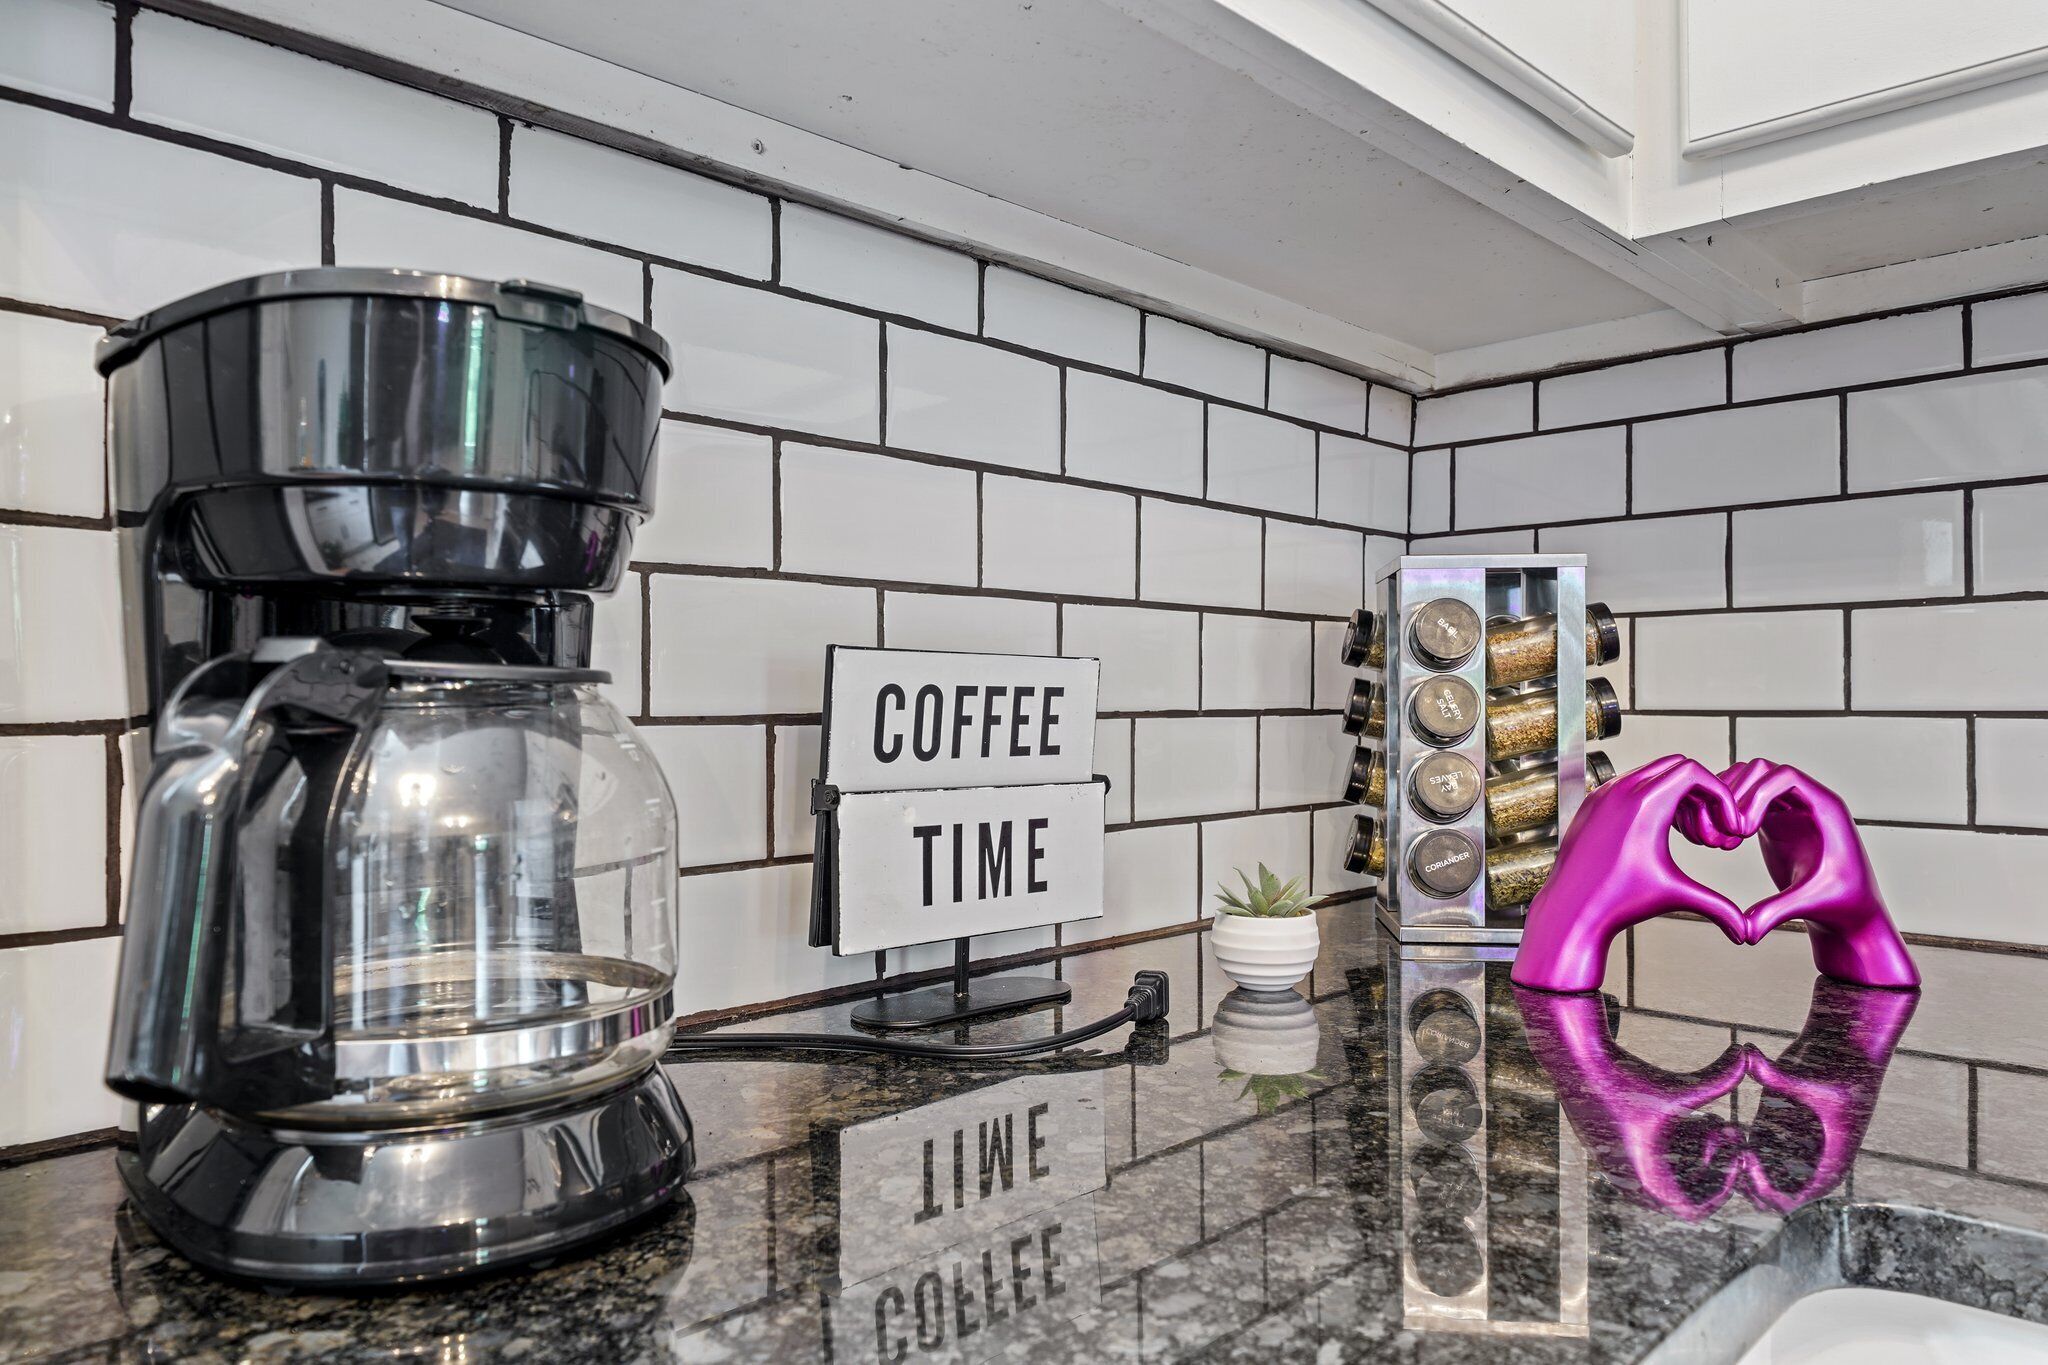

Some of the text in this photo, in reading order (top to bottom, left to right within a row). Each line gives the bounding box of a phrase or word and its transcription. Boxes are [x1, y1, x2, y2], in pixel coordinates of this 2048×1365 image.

[1436, 698, 1451, 718] SALT
[1443, 689, 1463, 720] CELERY
[873, 683, 1064, 763] COFFEE
[1429, 771, 1463, 785] LEAVES
[1441, 780, 1459, 792] BAY
[913, 818, 1048, 906] TIME
[1425, 851, 1470, 873] CORIANDER
